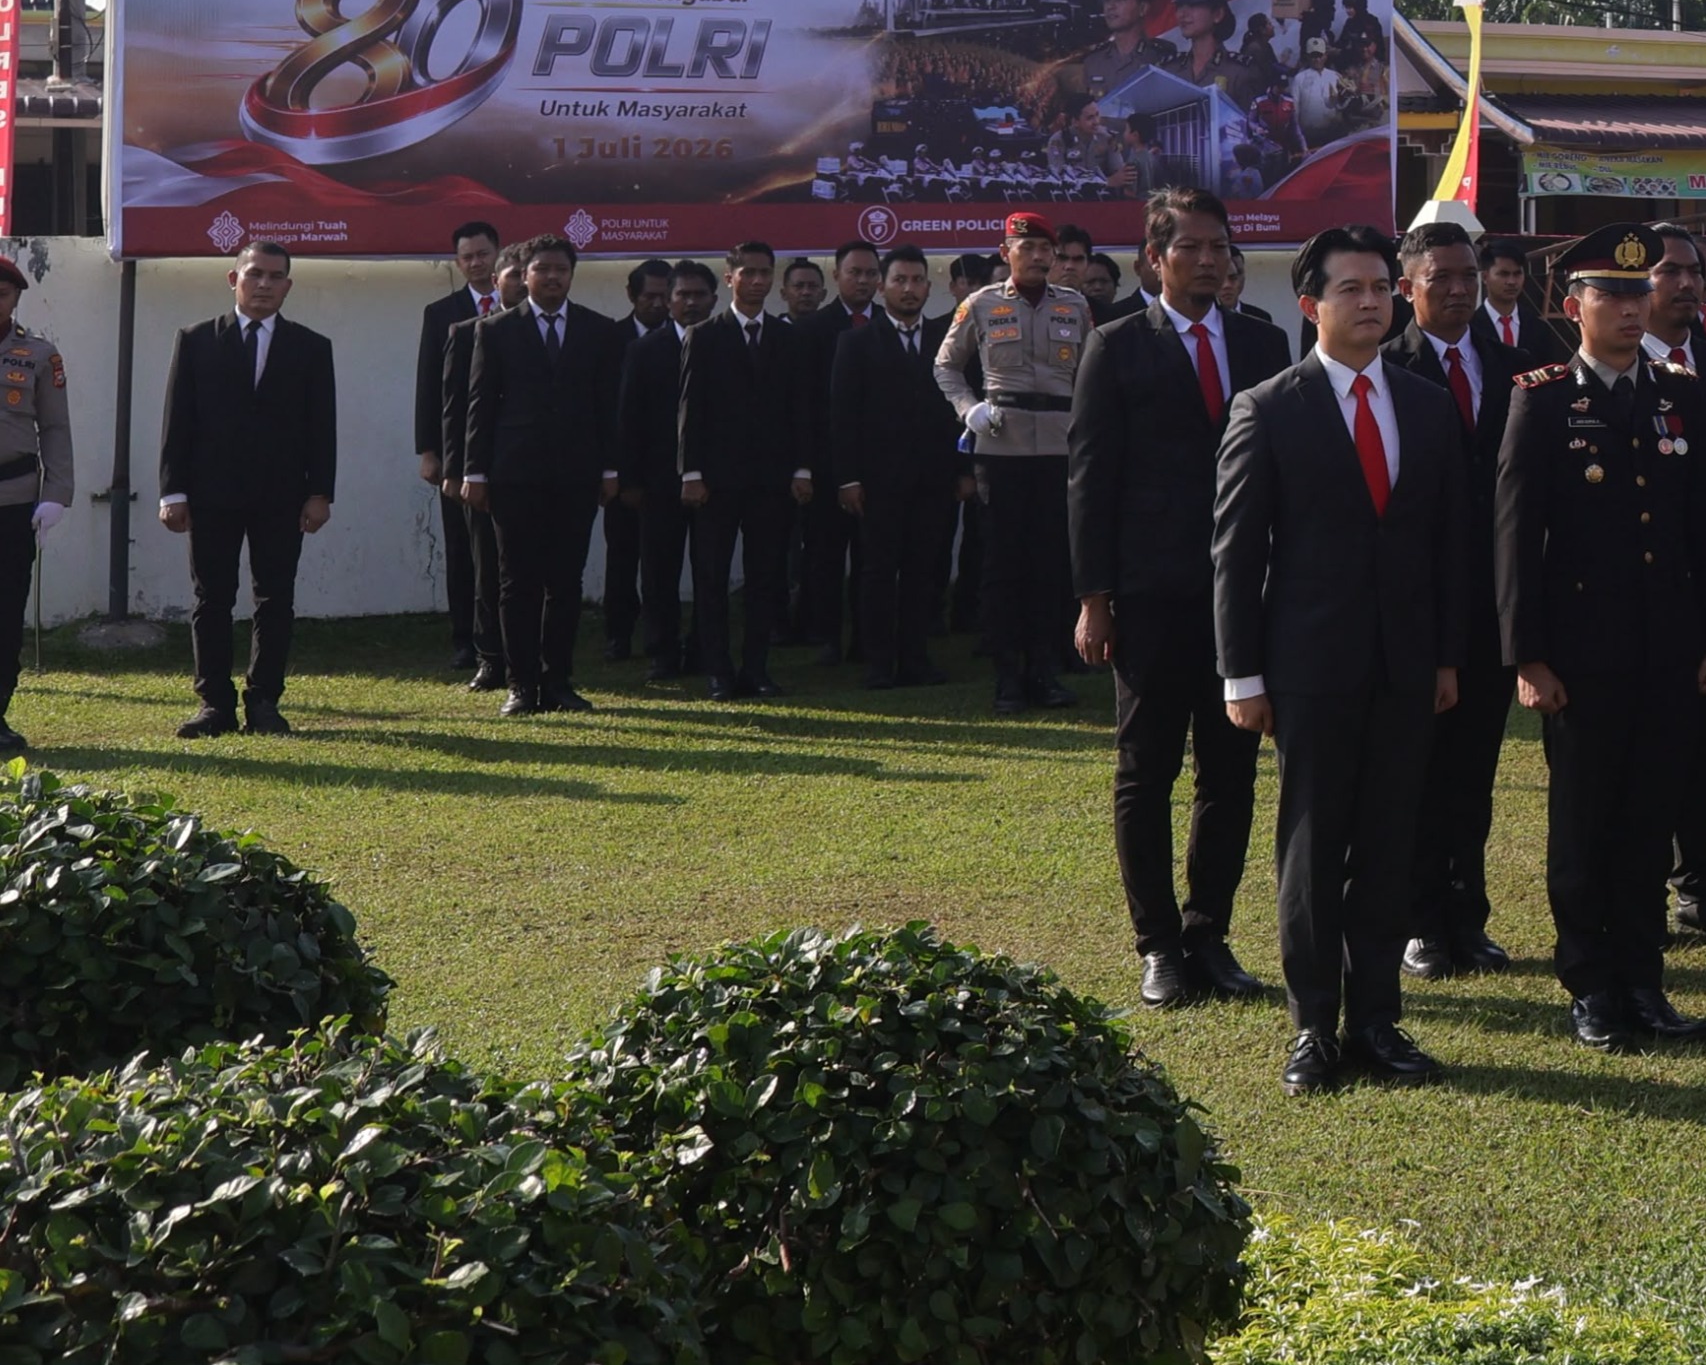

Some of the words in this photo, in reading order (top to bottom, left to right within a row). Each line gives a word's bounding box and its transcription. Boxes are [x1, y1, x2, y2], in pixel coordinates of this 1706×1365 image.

[532, 14, 773, 80] POLRI
[540, 100, 611, 117] Untuk
[616, 100, 748, 121] Masyarakat
[553, 137, 566, 159] 1
[577, 135, 642, 160] Juli
[653, 136, 734, 160] 2026
[1228, 213, 1244, 222] kan
[1246, 213, 1280, 222] Melayu
[249, 221, 315, 232] Melindungi
[317, 220, 348, 230] Tuah
[601, 218, 632, 228] POLRI
[634, 218, 670, 229] UNTUK
[901, 220, 952, 232] GREEN
[956, 220, 1006, 231] POLICI
[1243, 223, 1254, 232] Di
[1256, 223, 1281, 232] Bumi
[249, 233, 299, 243] Menjaga
[301, 232, 348, 242] Marwah
[601, 231, 669, 241] MASYARAKAT
[1050, 316, 1077, 326] POLRI
[3, 357, 36, 369] POLRI
